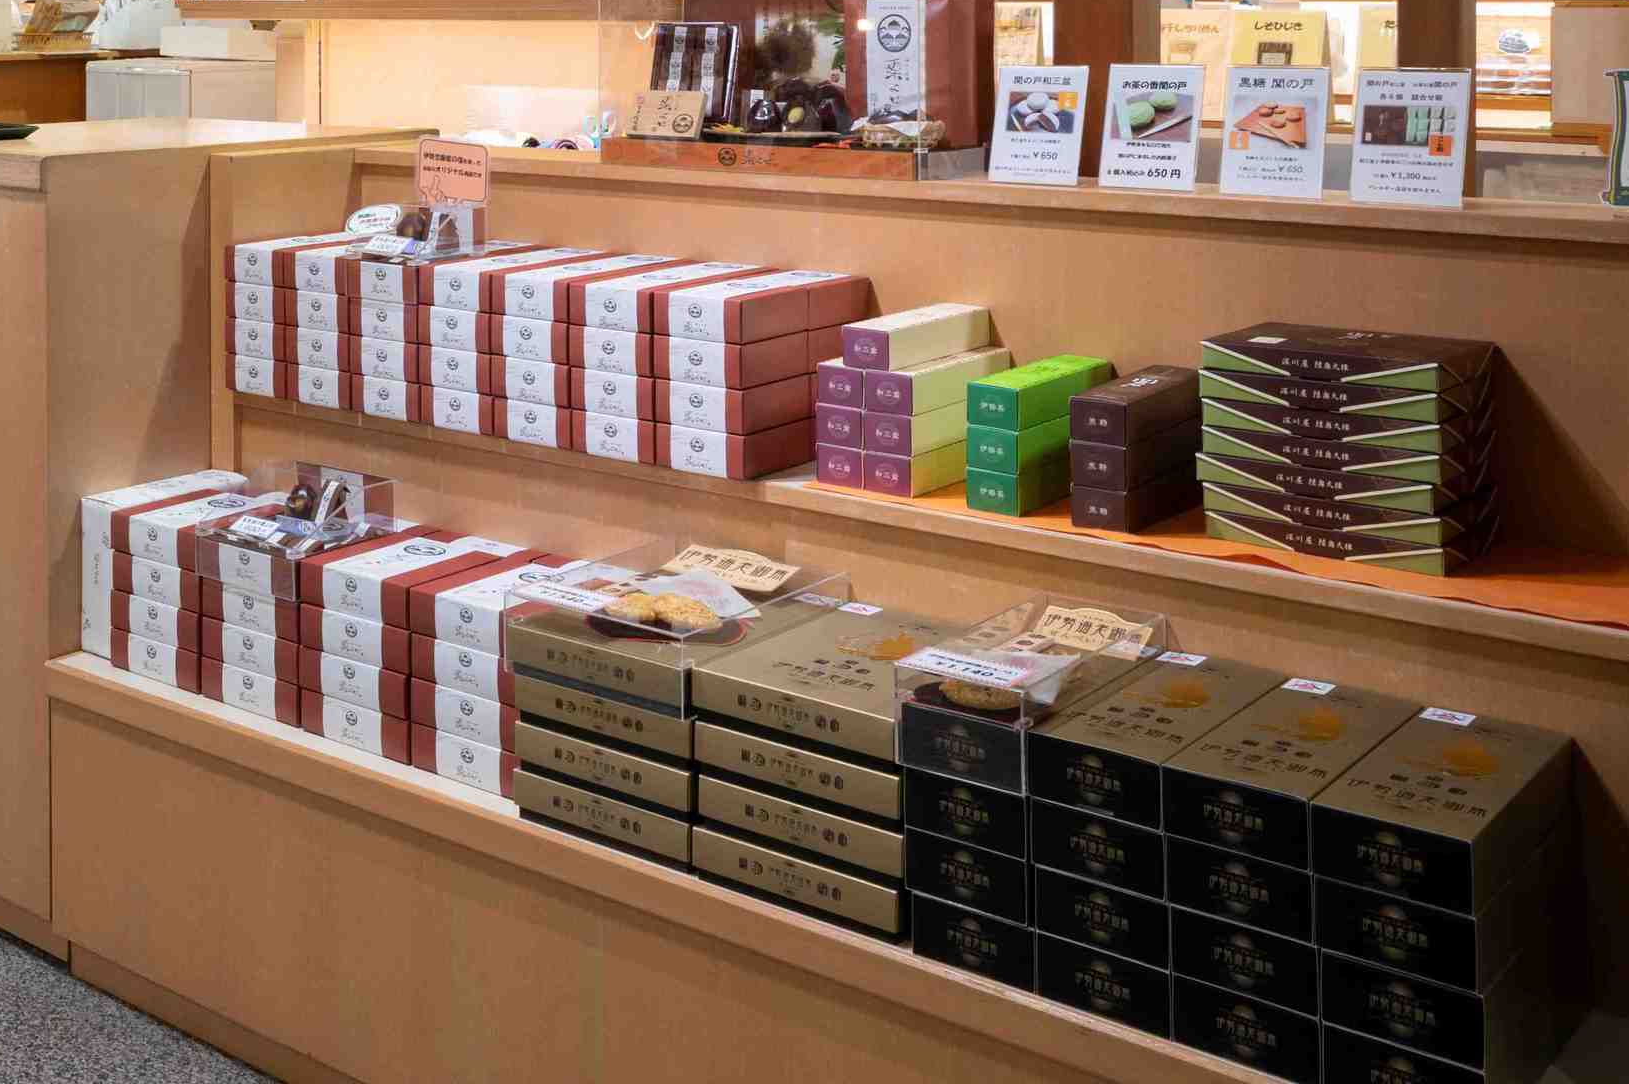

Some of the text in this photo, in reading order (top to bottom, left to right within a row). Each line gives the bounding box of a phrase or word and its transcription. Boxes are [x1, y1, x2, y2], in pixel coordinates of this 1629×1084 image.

[1254, 20, 1304, 31] しそひじき
[1238, 77, 1315, 89] 黒糖 関の戸
